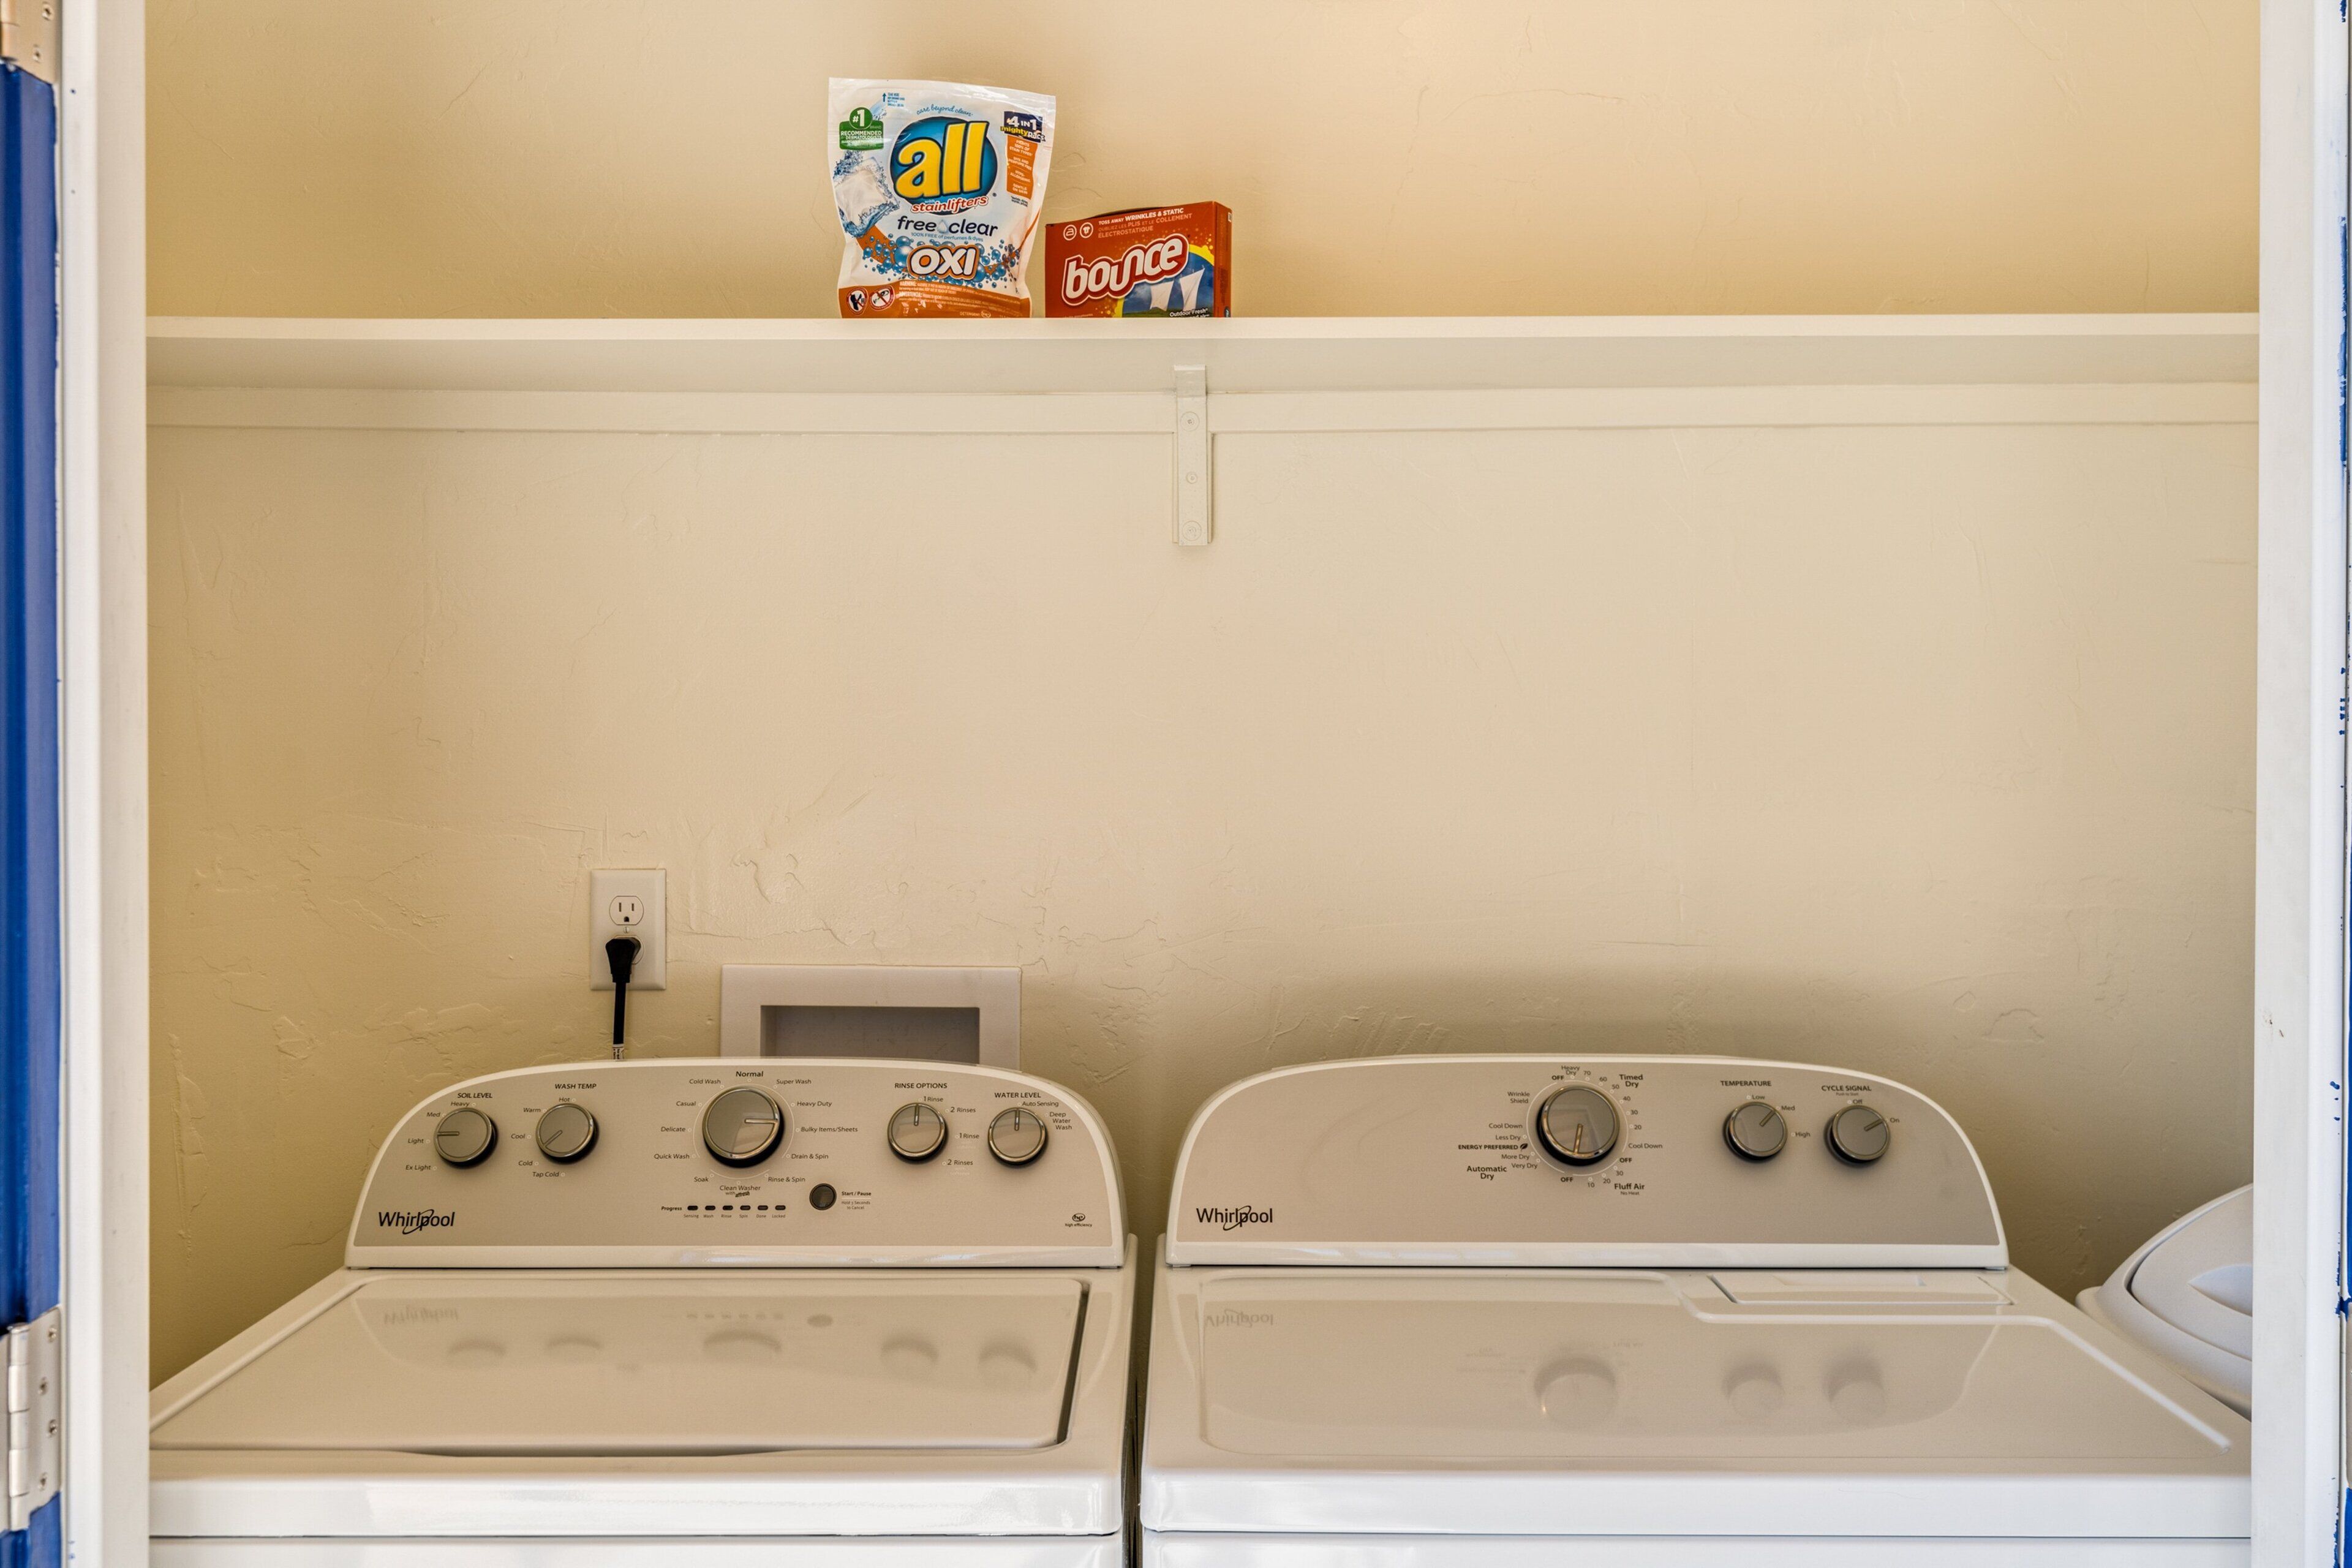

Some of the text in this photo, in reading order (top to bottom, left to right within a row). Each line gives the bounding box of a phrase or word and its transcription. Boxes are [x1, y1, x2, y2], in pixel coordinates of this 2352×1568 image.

[931, 104, 954, 113] beyond
[853, 109, 865, 127] #1
[1007, 116, 1020, 127] 4
[1030, 119, 1037, 130] 1
[1001, 126, 1028, 136] mighty
[895, 120, 990, 198] all
[911, 196, 988, 213] stainlifters
[1125, 211, 1157, 221] WRINKLES
[1156, 213, 1193, 223] COLLEMENT
[897, 216, 998, 236] free clear
[910, 247, 976, 276] OXI
[1065, 238, 1182, 300] bounce
[379, 1208, 455, 1235] Whirlpool
[1196, 1206, 1273, 1231] Whirlpool
